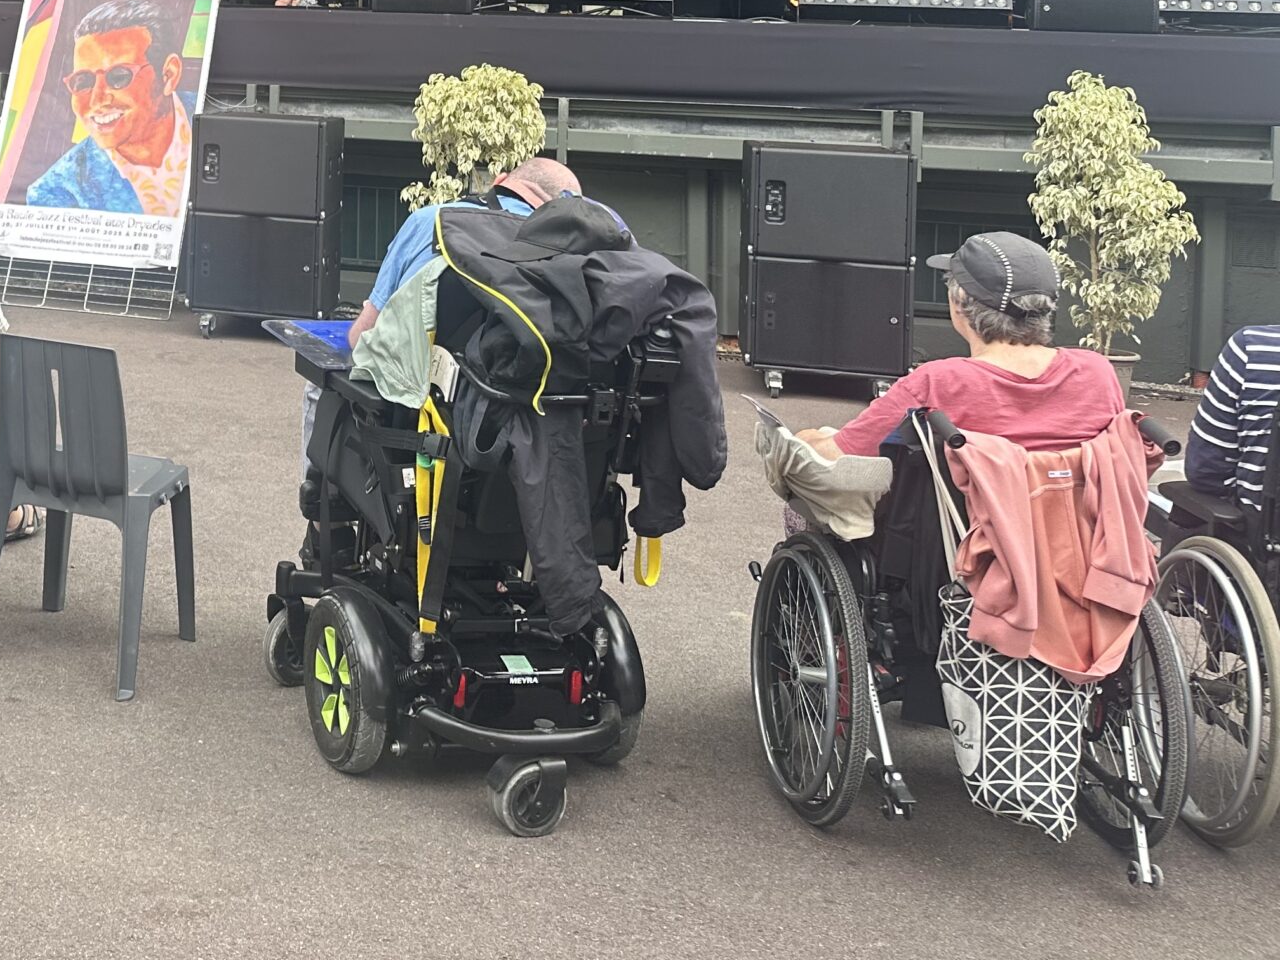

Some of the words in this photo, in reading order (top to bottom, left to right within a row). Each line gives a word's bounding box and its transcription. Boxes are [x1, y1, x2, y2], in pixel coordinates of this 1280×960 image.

[7, 208, 34, 220] Baule
[36, 210, 60, 222] Jazz
[62, 211, 102, 226] Festival
[105, 220, 125, 228] aux
[127, 217, 173, 232] Dryades
[509, 676, 539, 685] MEYRA
